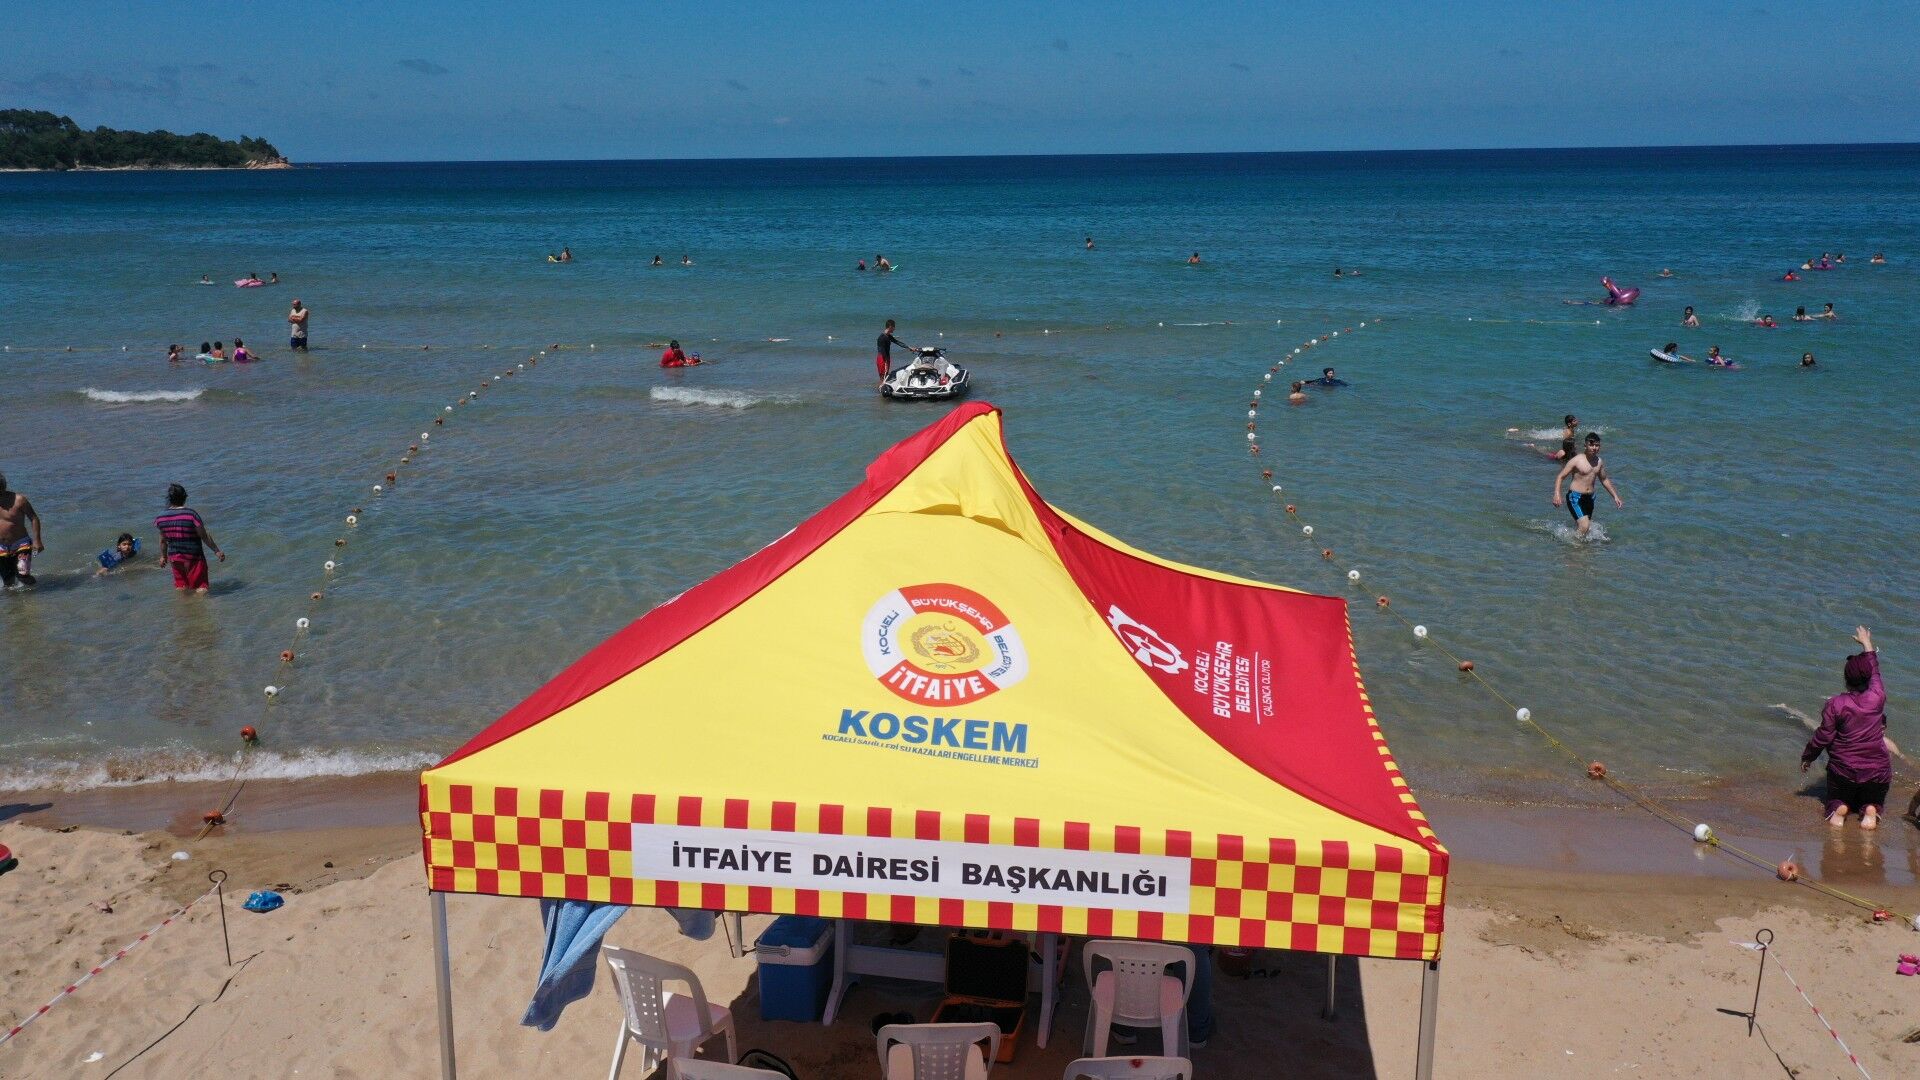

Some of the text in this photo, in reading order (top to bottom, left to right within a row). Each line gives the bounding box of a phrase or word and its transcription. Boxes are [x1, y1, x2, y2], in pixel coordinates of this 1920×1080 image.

[878, 610, 899, 656] KOCAELİ
[911, 598, 994, 630] BÜYÜKŞEHİR
[888, 666, 985, 700] İTFAİYE
[1194, 650, 1210, 695] KOCAELİ
[1212, 641, 1233, 719] BÜYÜKŞEHİR
[1235, 656, 1251, 714] BELEDİYESİ
[838, 708, 1028, 753] KOSKEM
[952, 752, 1001, 765] ENGELLEME
[1002, 757, 1039, 769] MERKEZİ
[671, 841, 1167, 898] İTFAİYE DAİRESİ BAŞKANLIĞI
